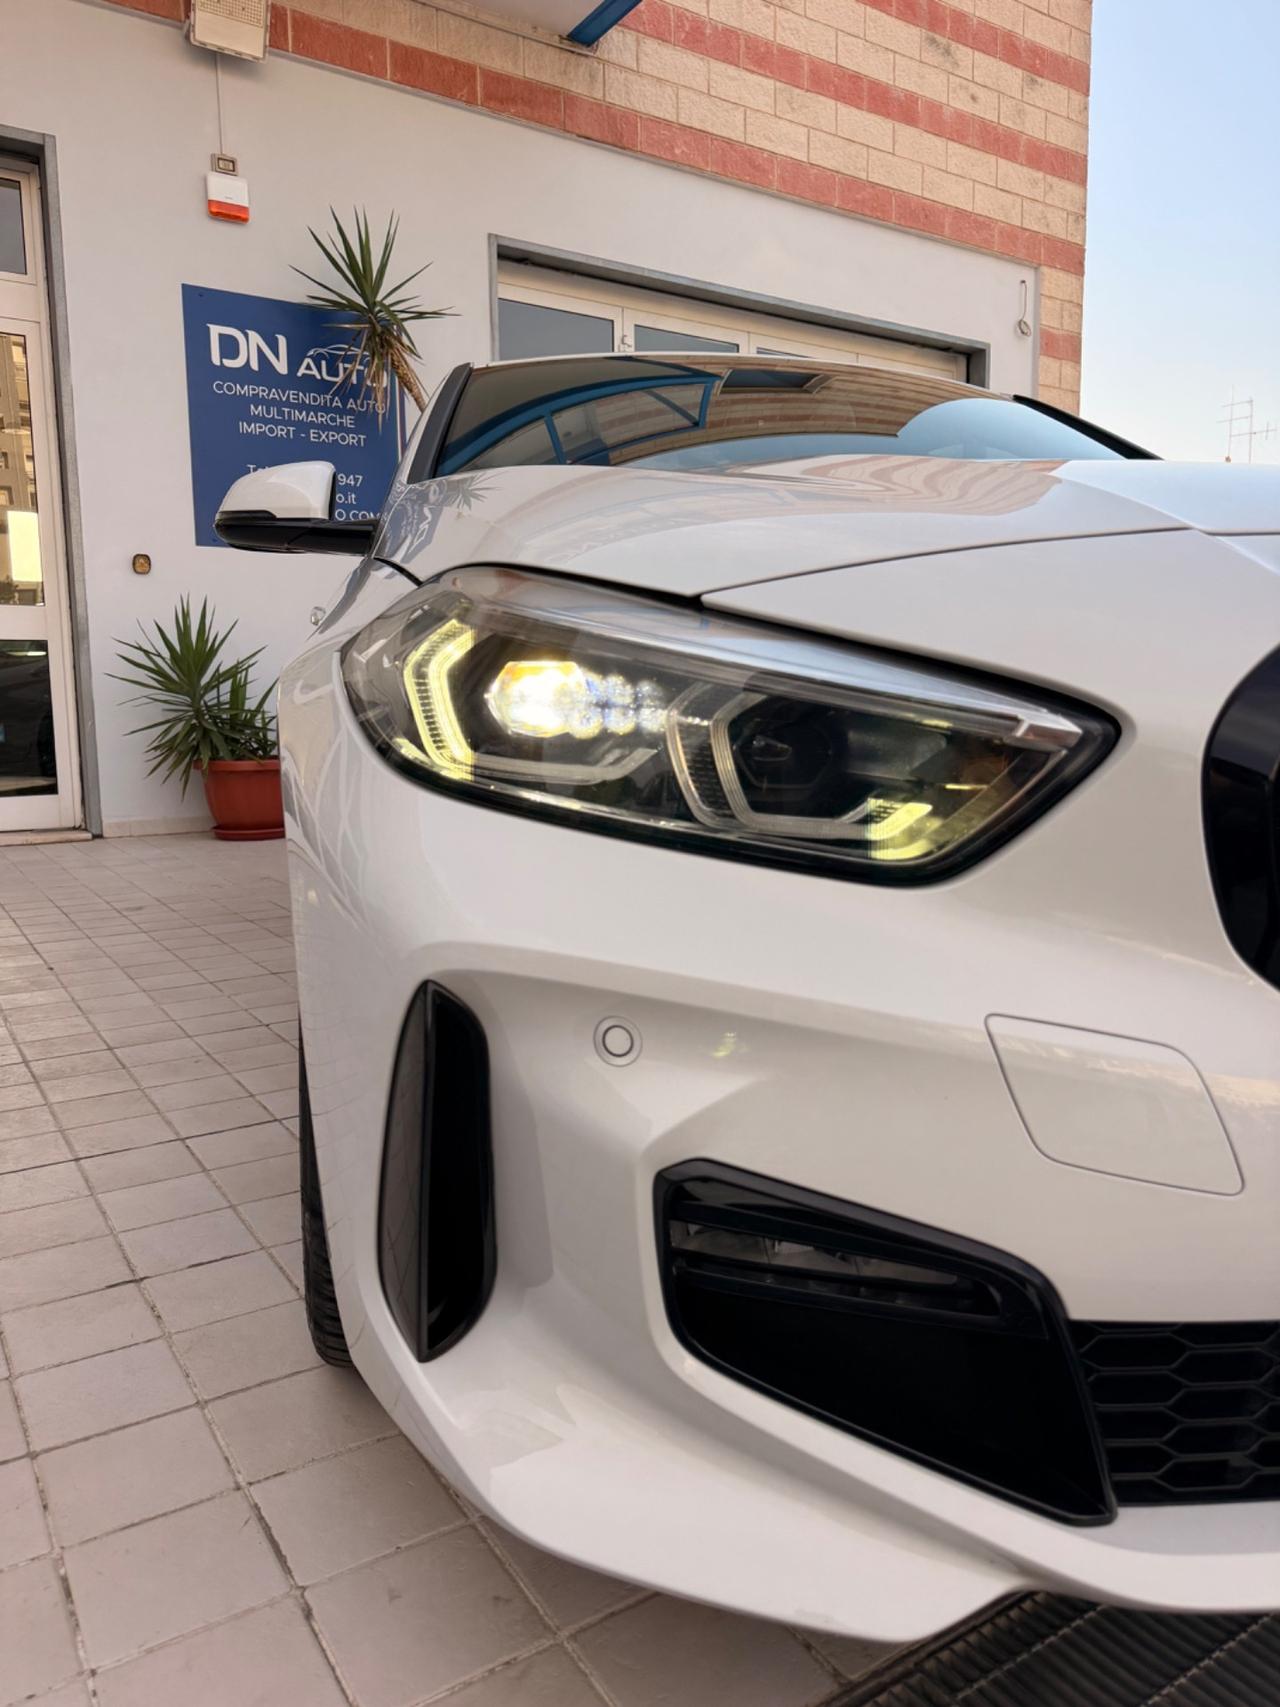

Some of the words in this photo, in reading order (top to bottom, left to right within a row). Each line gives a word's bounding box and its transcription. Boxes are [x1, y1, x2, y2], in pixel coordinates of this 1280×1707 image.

[206, 323, 288, 375] DN
[213, 380, 343, 409] COMPRAVENDITA
[346, 397, 386, 414] AUTO
[250, 404, 356, 429] MULTIMARCHE
[239, 421, 296, 439] IMPORT
[310, 429, 367, 447] EXPORT
[337, 473, 363, 487] 947
